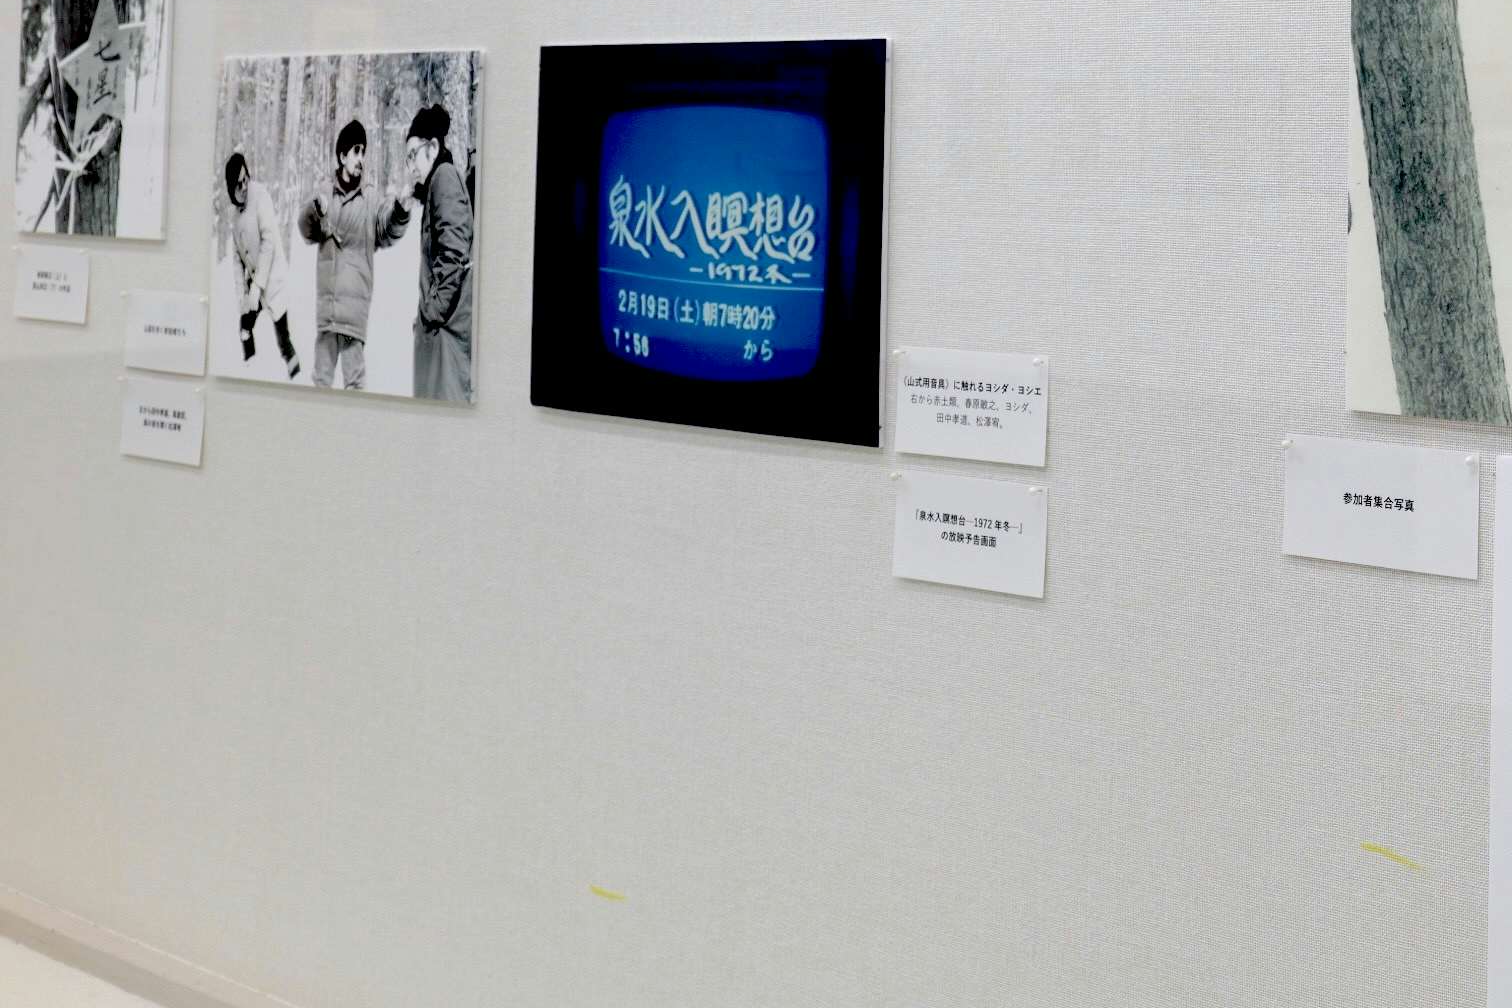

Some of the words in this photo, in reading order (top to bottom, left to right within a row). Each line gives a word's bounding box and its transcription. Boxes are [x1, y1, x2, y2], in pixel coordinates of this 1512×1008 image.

[608, 174, 816, 264] 泉水入瞑想台
[744, 339, 773, 361] から
[1343, 492, 1415, 512] 参加者集合写真
[941, 531, 997, 548] の放映予告画面
